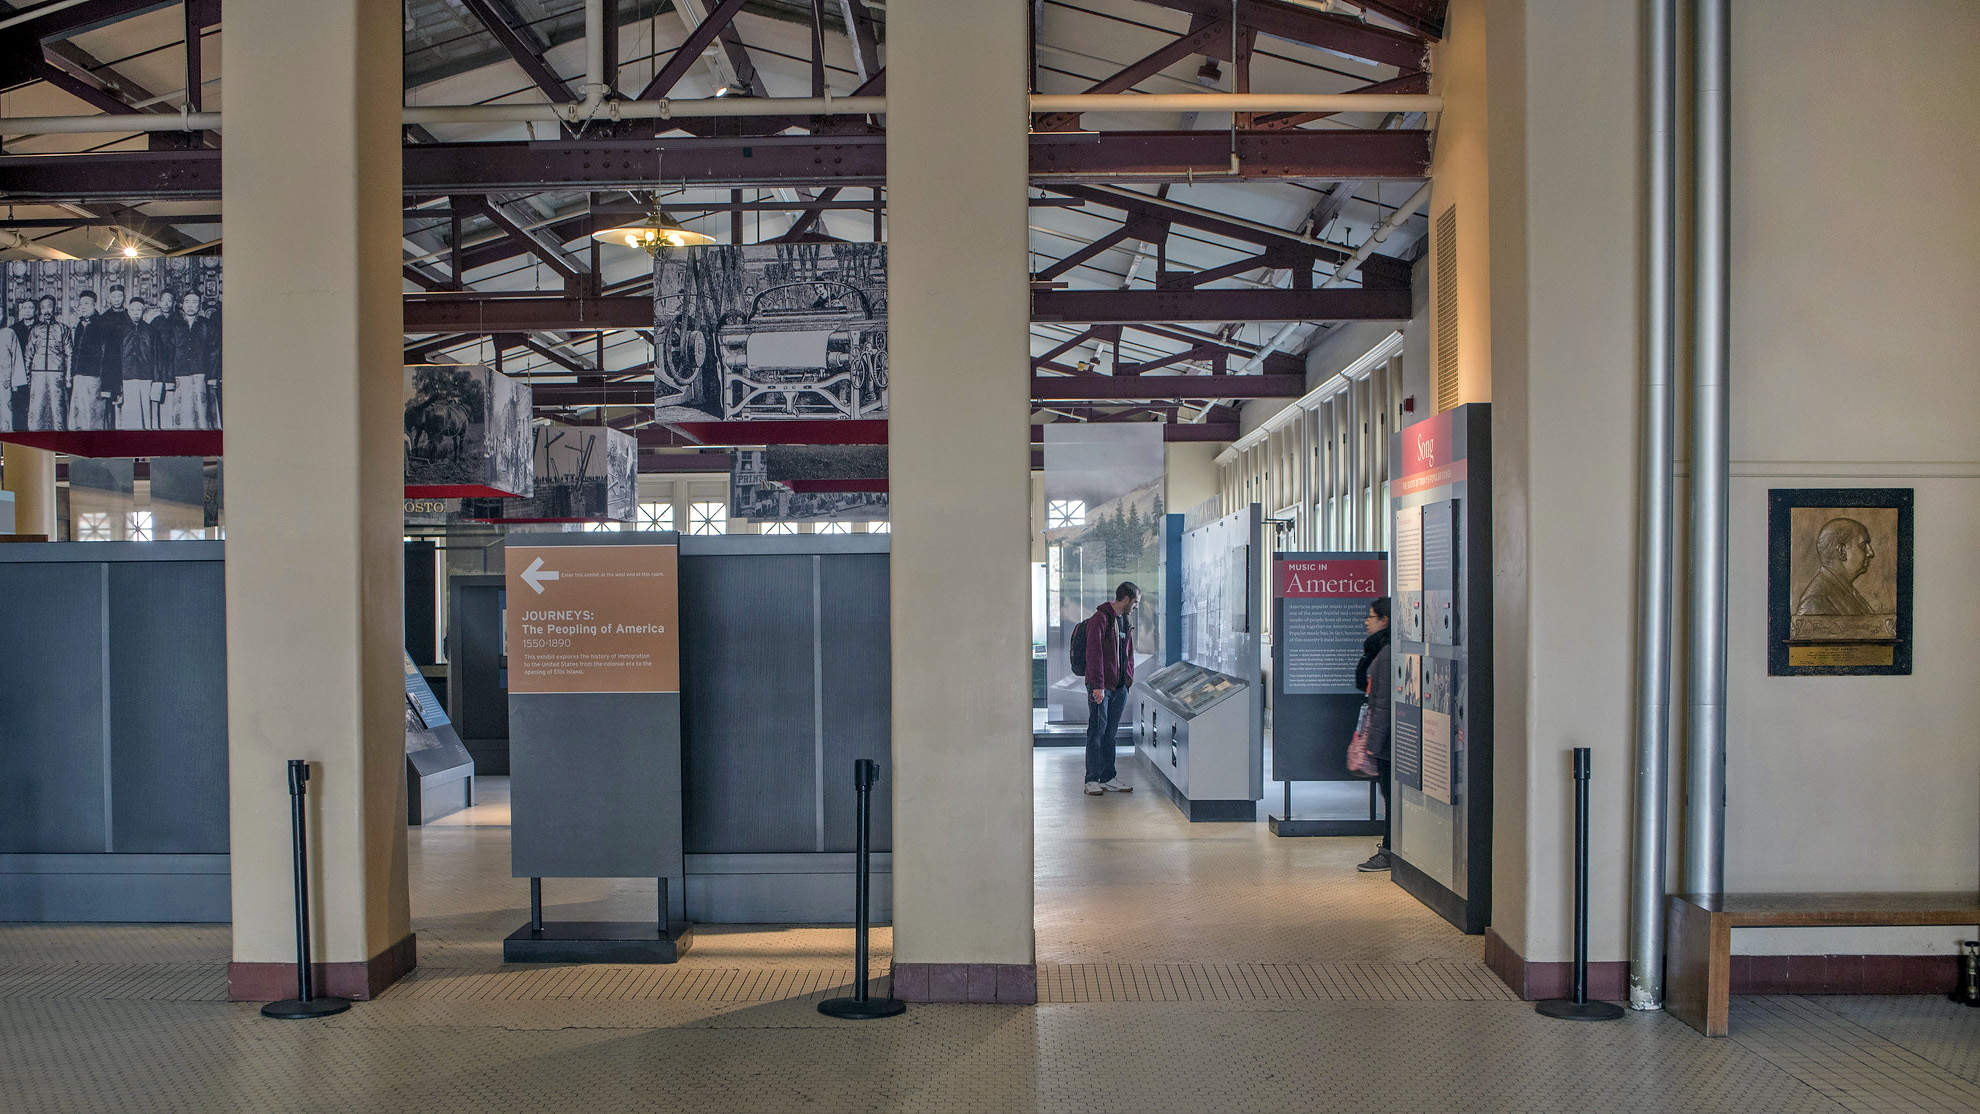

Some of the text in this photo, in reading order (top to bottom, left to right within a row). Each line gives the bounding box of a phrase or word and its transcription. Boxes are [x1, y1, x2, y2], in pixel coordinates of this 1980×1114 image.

[1417, 433, 1434, 468] Song
[1286, 573, 1376, 592] America
[522, 610, 594, 620] JOURNEYS:
[522, 624, 665, 635] The Peopling of America
[523, 639, 571, 648] 1550-1890
